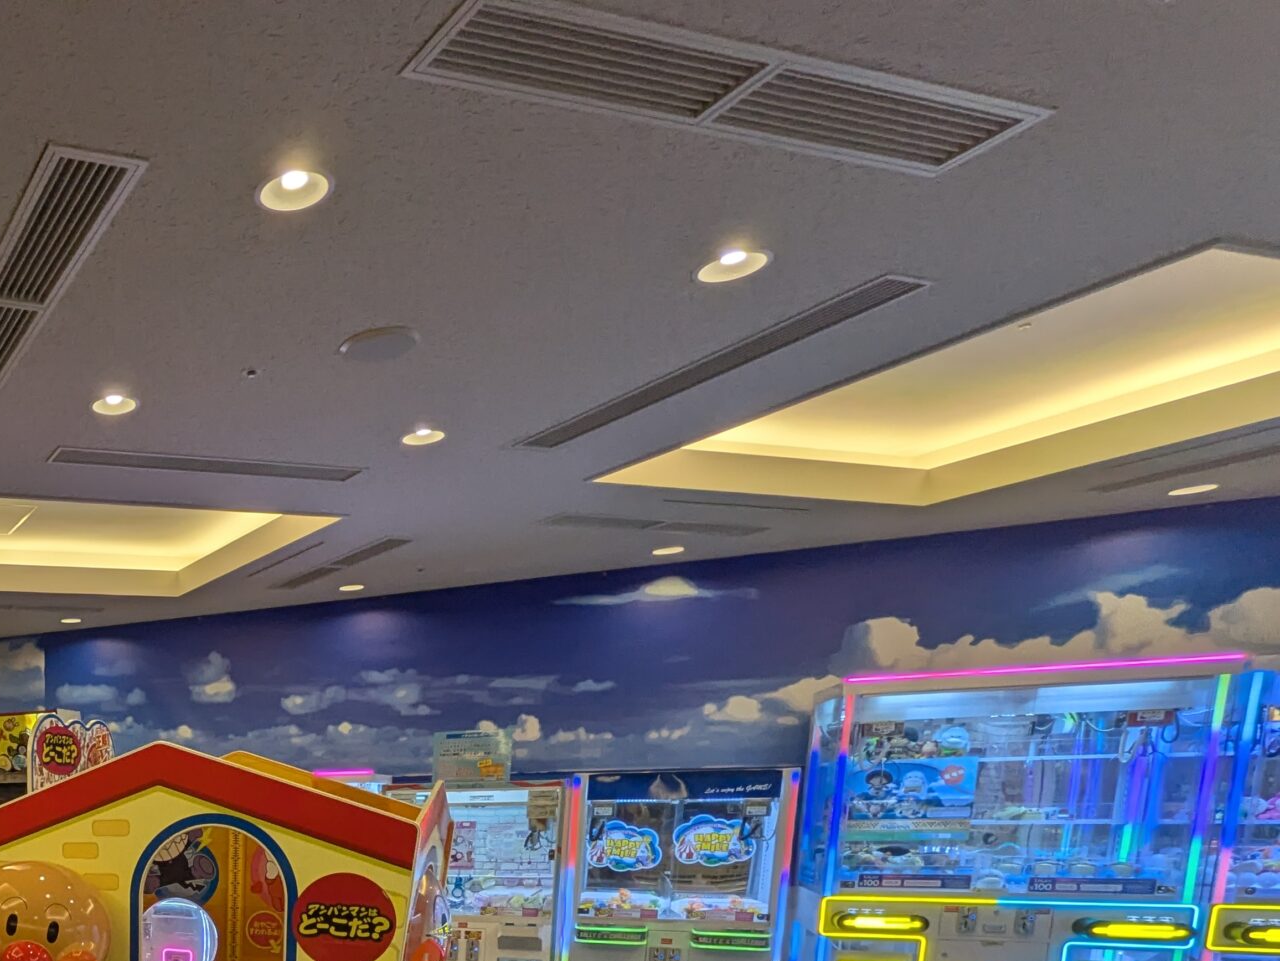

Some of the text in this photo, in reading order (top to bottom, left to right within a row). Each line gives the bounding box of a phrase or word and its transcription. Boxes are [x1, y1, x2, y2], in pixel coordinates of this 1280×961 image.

[42, 743, 78, 765] どーこだ?
[307, 904, 379, 917] アンパンマンは
[298, 914, 391, 940] どーこだ?
